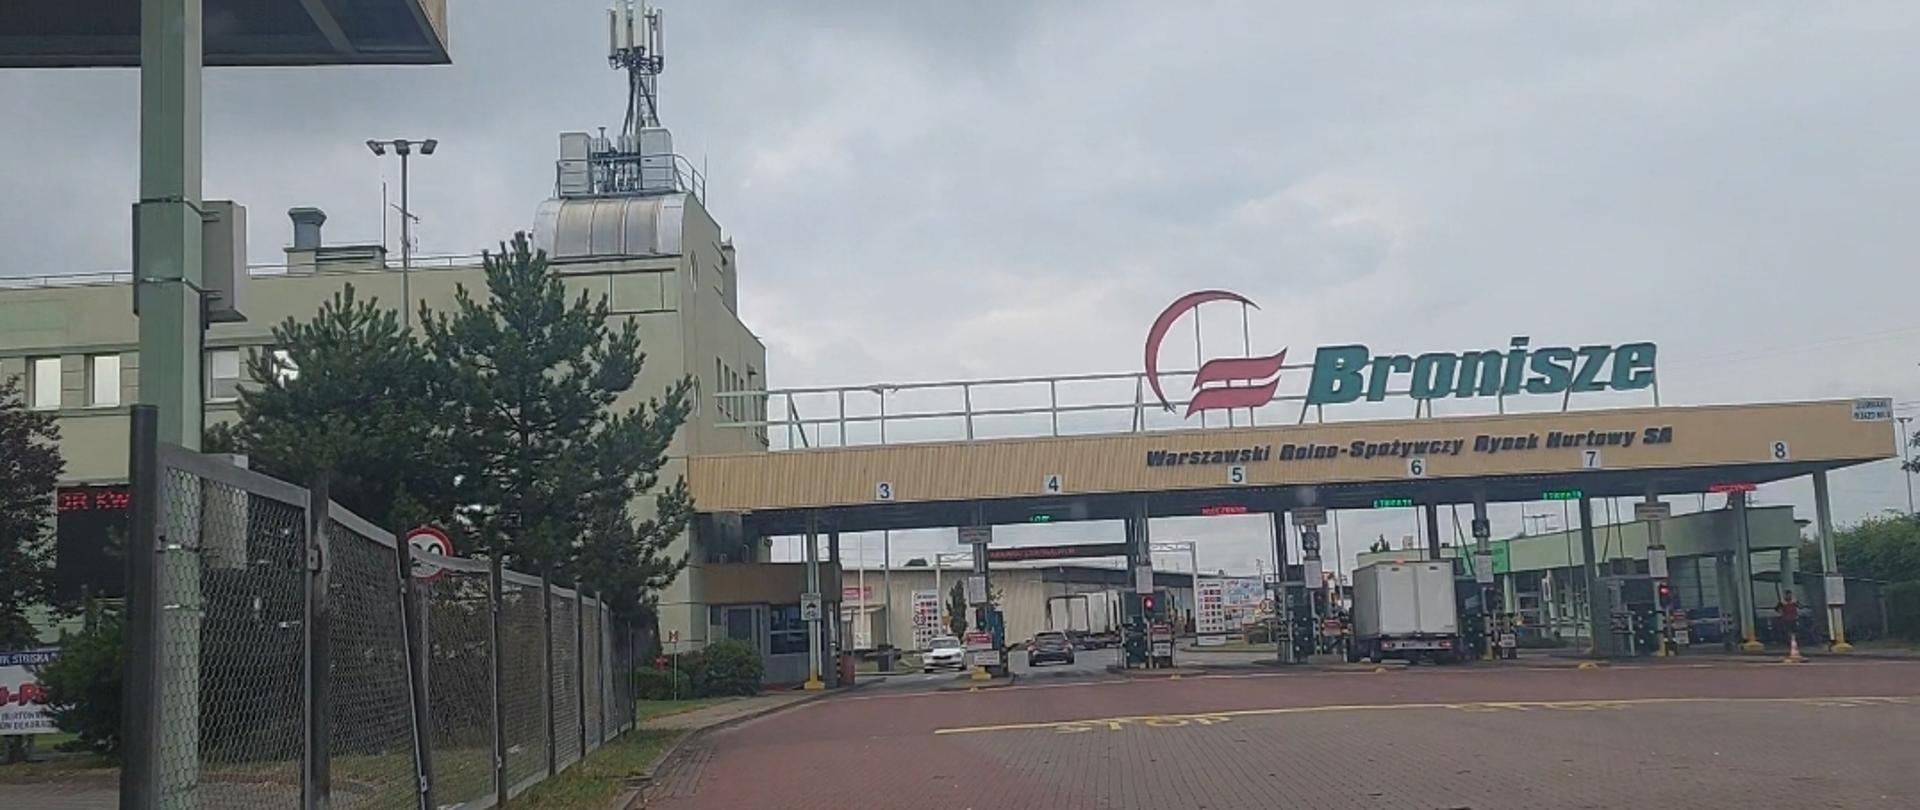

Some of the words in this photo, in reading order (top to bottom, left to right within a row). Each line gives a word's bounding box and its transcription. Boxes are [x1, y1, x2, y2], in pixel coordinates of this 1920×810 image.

[1307, 336, 1657, 405] Bronisze
[1147, 445, 1271, 467] Warszawski
[1279, 438, 1464, 461] Rolno-Spożywczy
[1474, 433, 1540, 455] Rynek
[1546, 429, 1636, 449] Hurtowy
[1643, 427, 1673, 445] SA
[1774, 442, 1786, 459] 8
[1410, 459, 1422, 475] 6
[1585, 451, 1597, 467] 7
[1048, 475, 1059, 491] 4
[1231, 467, 1243, 483] 5
[879, 483, 890, 499] 3
